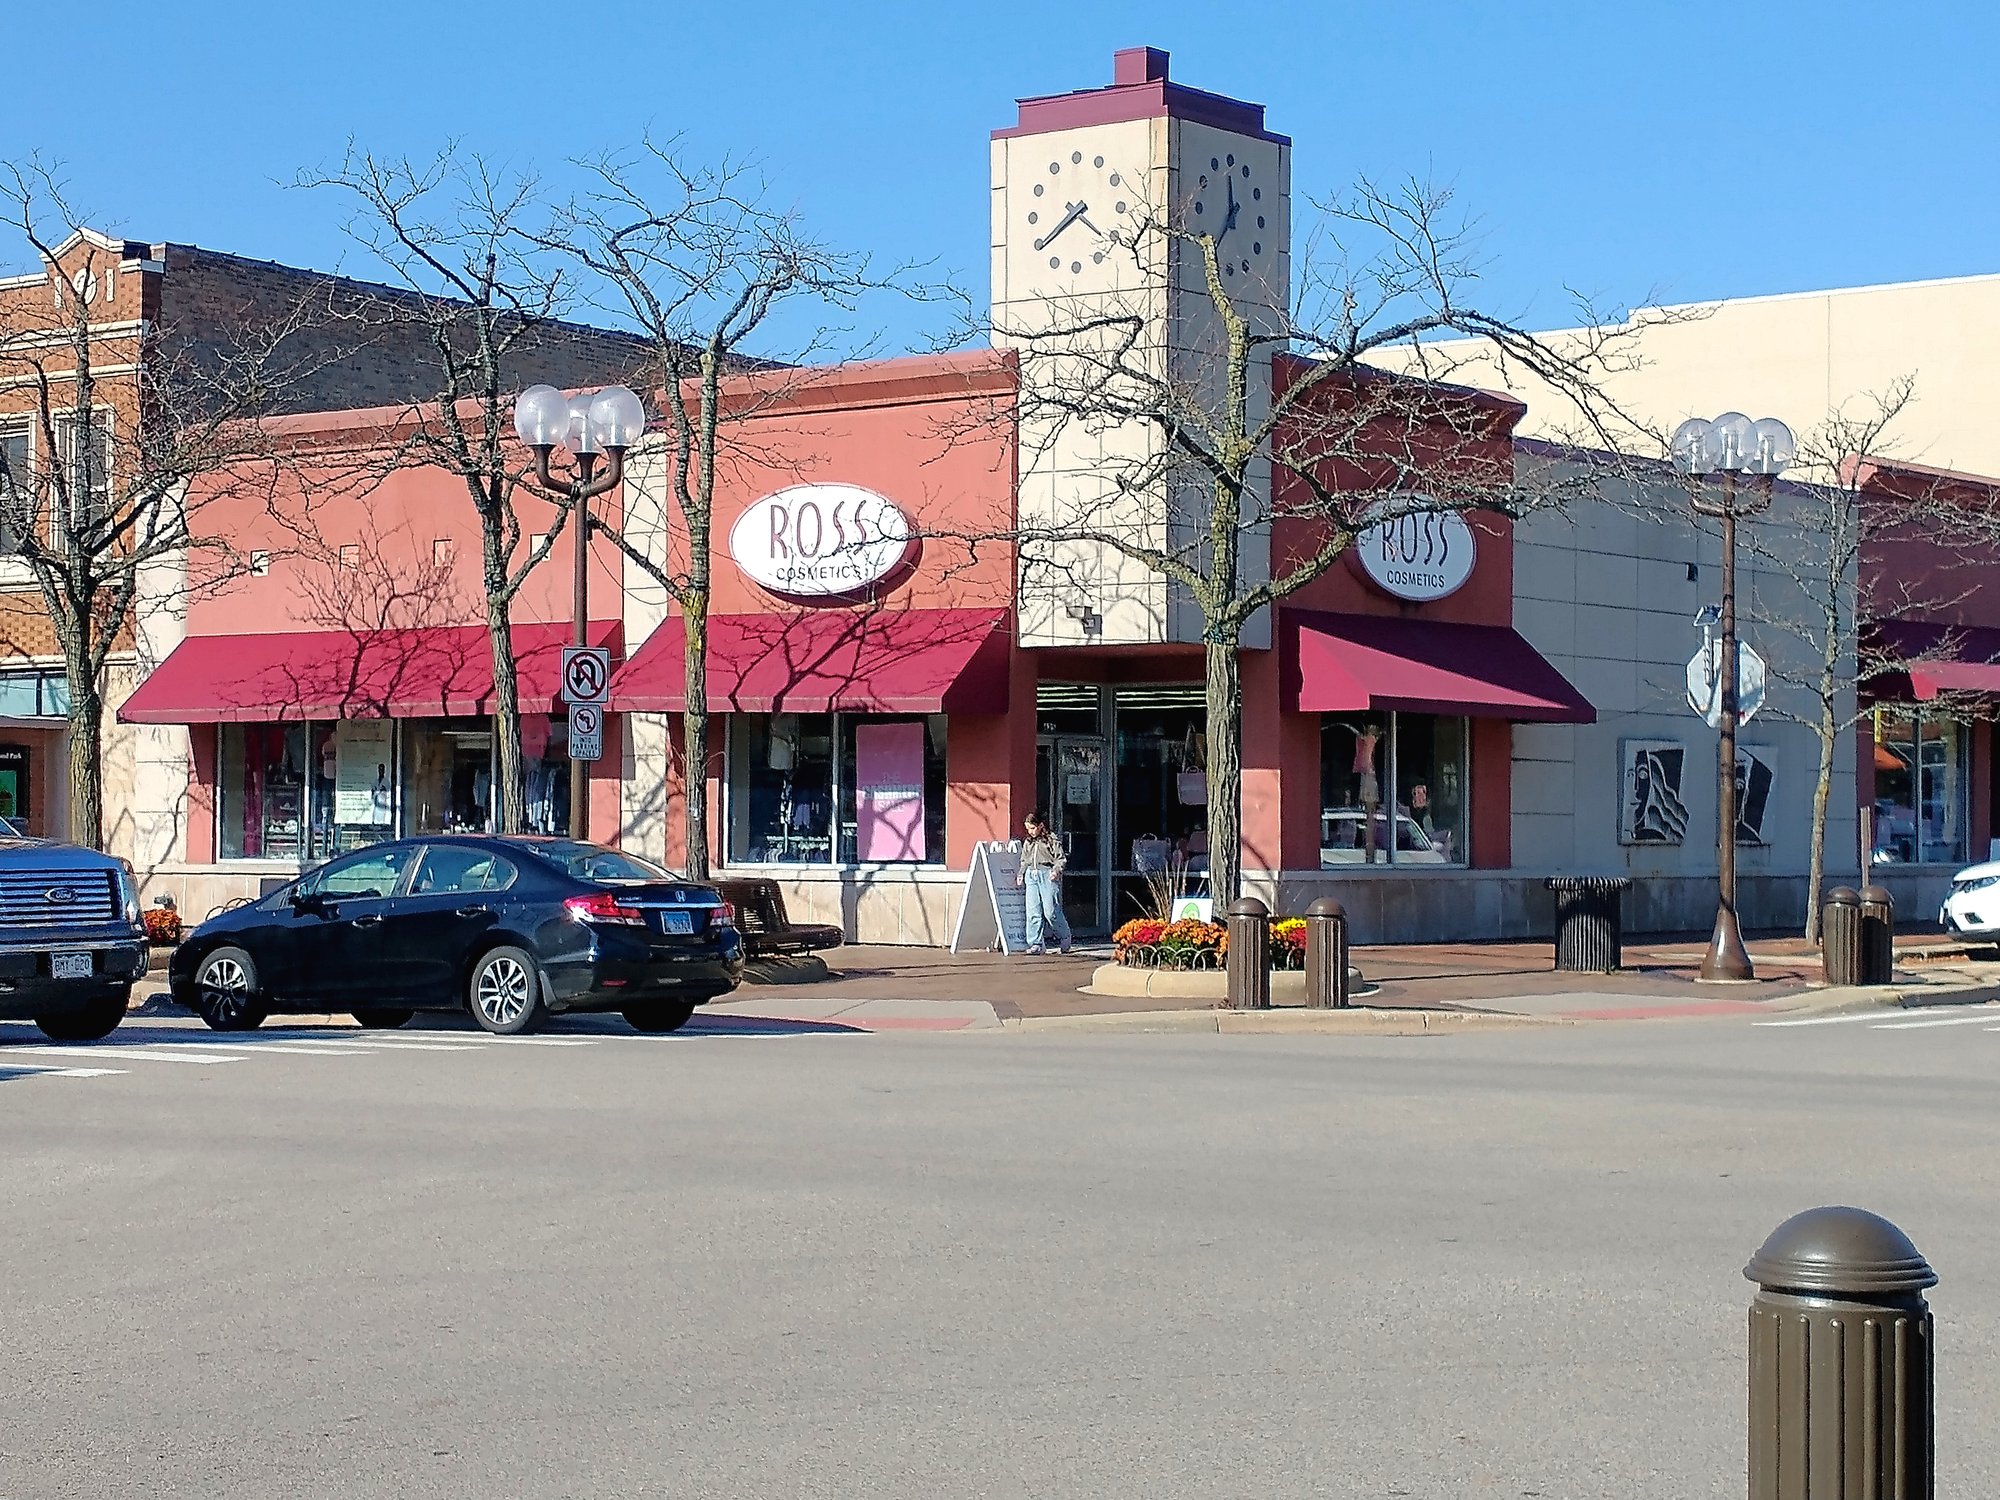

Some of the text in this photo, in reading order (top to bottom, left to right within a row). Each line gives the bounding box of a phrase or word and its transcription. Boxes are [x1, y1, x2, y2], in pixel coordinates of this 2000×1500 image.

[770, 500, 867, 559] ROSS
[1382, 511, 1449, 567] ROSS
[776, 565, 862, 581] COSMETICS
[1386, 570, 1445, 588] COSMETICS
